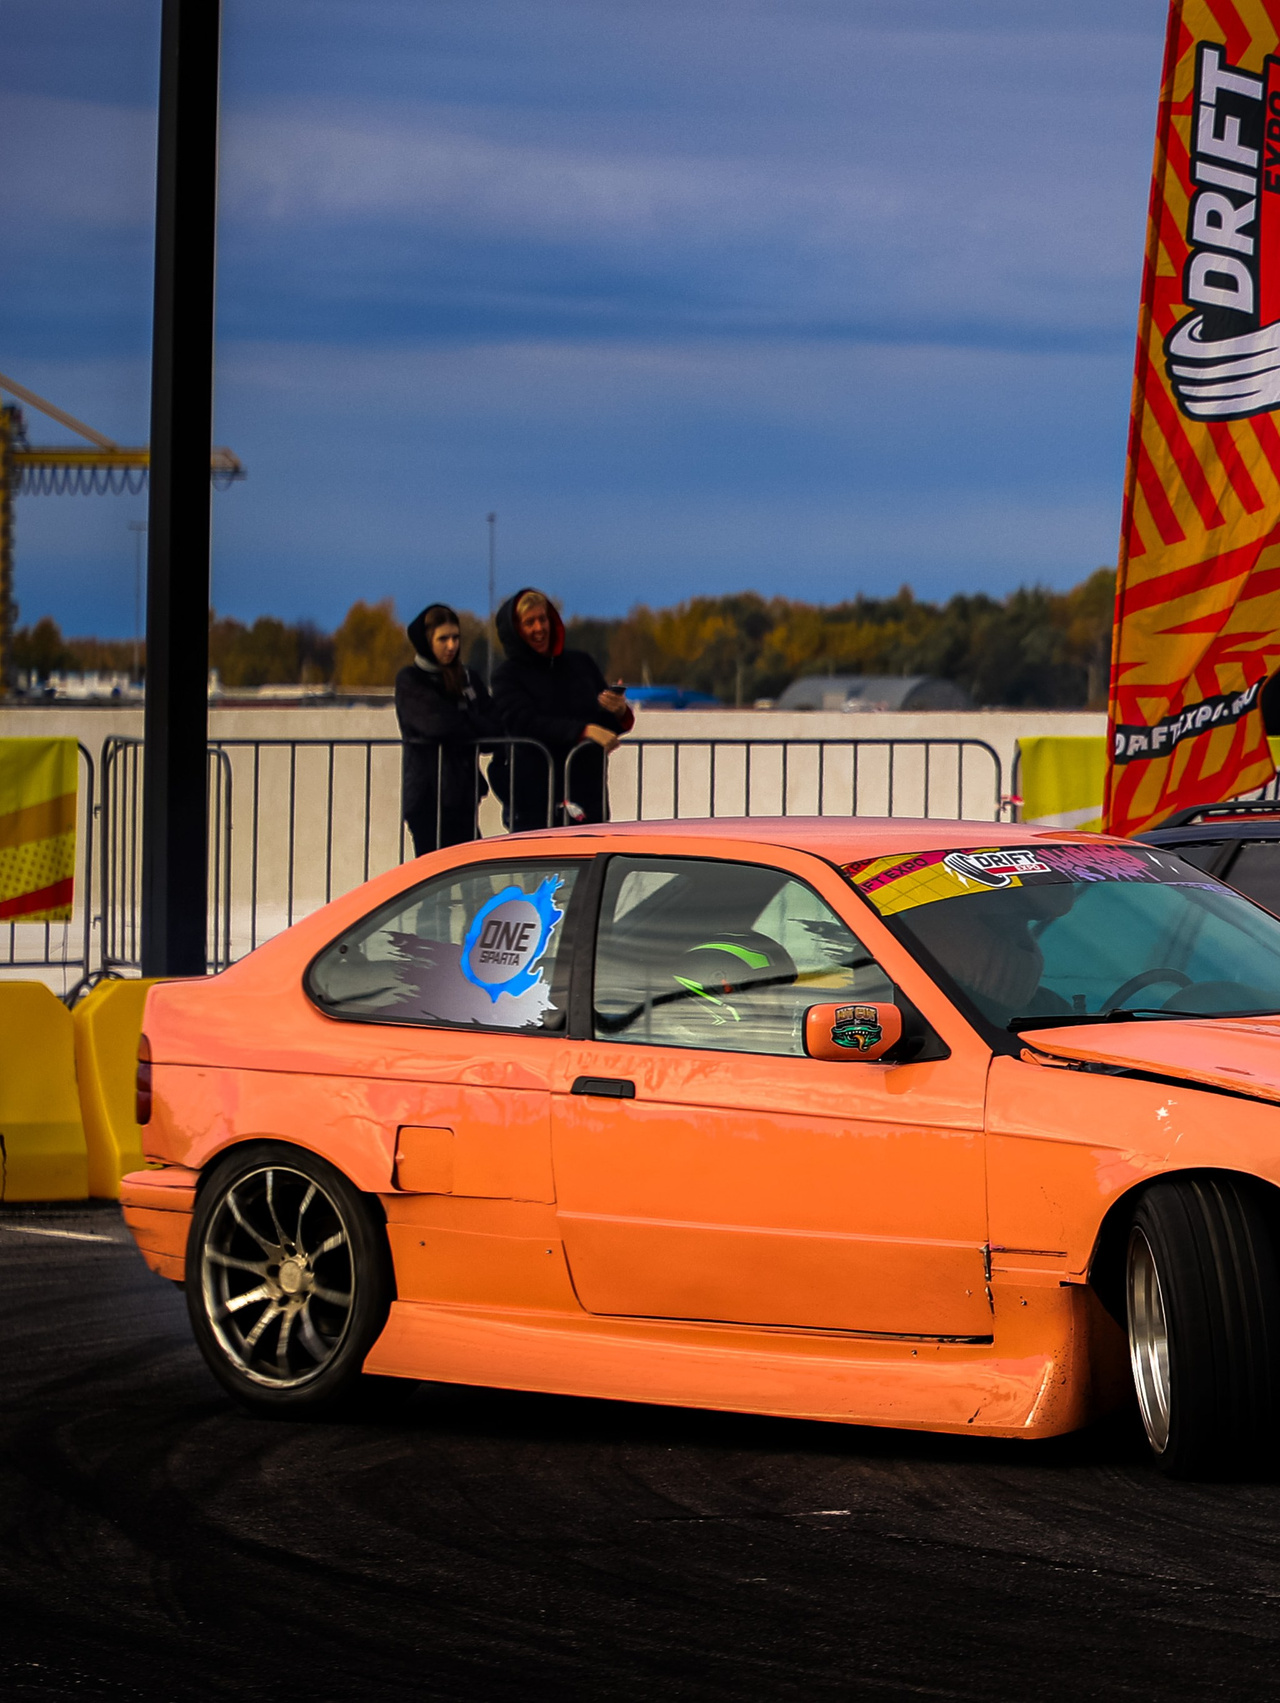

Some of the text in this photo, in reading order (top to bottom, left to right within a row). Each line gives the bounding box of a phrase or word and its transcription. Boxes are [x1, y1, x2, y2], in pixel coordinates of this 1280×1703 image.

[1188, 48, 1263, 314] DRIFT
[884, 858, 928, 880] EXPO
[973, 853, 1035, 868] DRIFT
[480, 920, 537, 952] ONE
[479, 950, 520, 967] SPARTA
